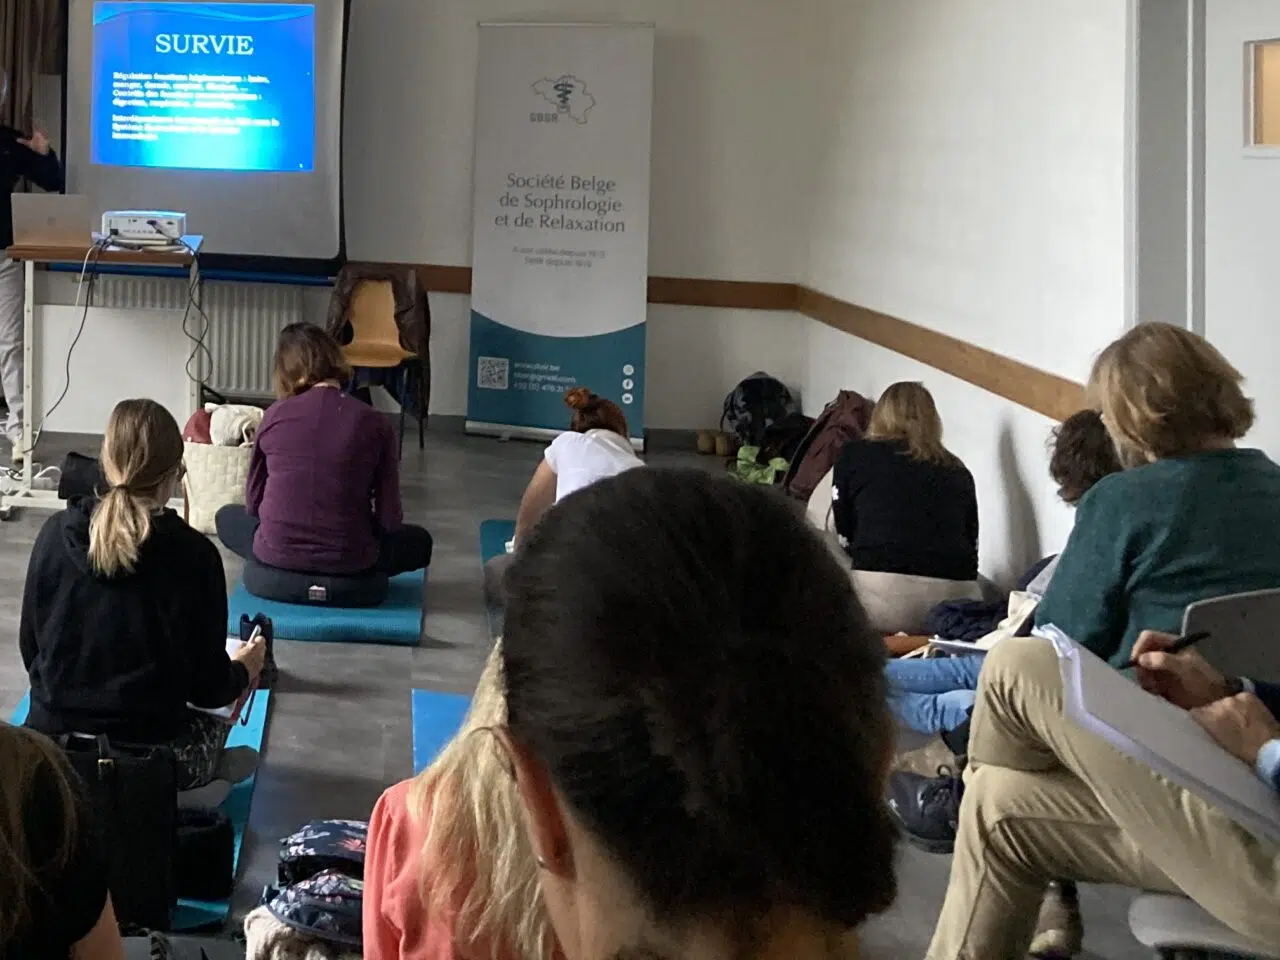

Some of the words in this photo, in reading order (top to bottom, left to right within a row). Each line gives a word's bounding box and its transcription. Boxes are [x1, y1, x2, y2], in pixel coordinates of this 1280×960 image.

[155, 33, 254, 55] SURVIE
[506, 172, 565, 190] Société
[571, 175, 616, 195] Belge
[499, 192, 520, 208] de
[524, 193, 622, 215] Sophrologie
[494, 214, 509, 227] et
[514, 212, 534, 228] de
[539, 214, 625, 233] Relaxation
